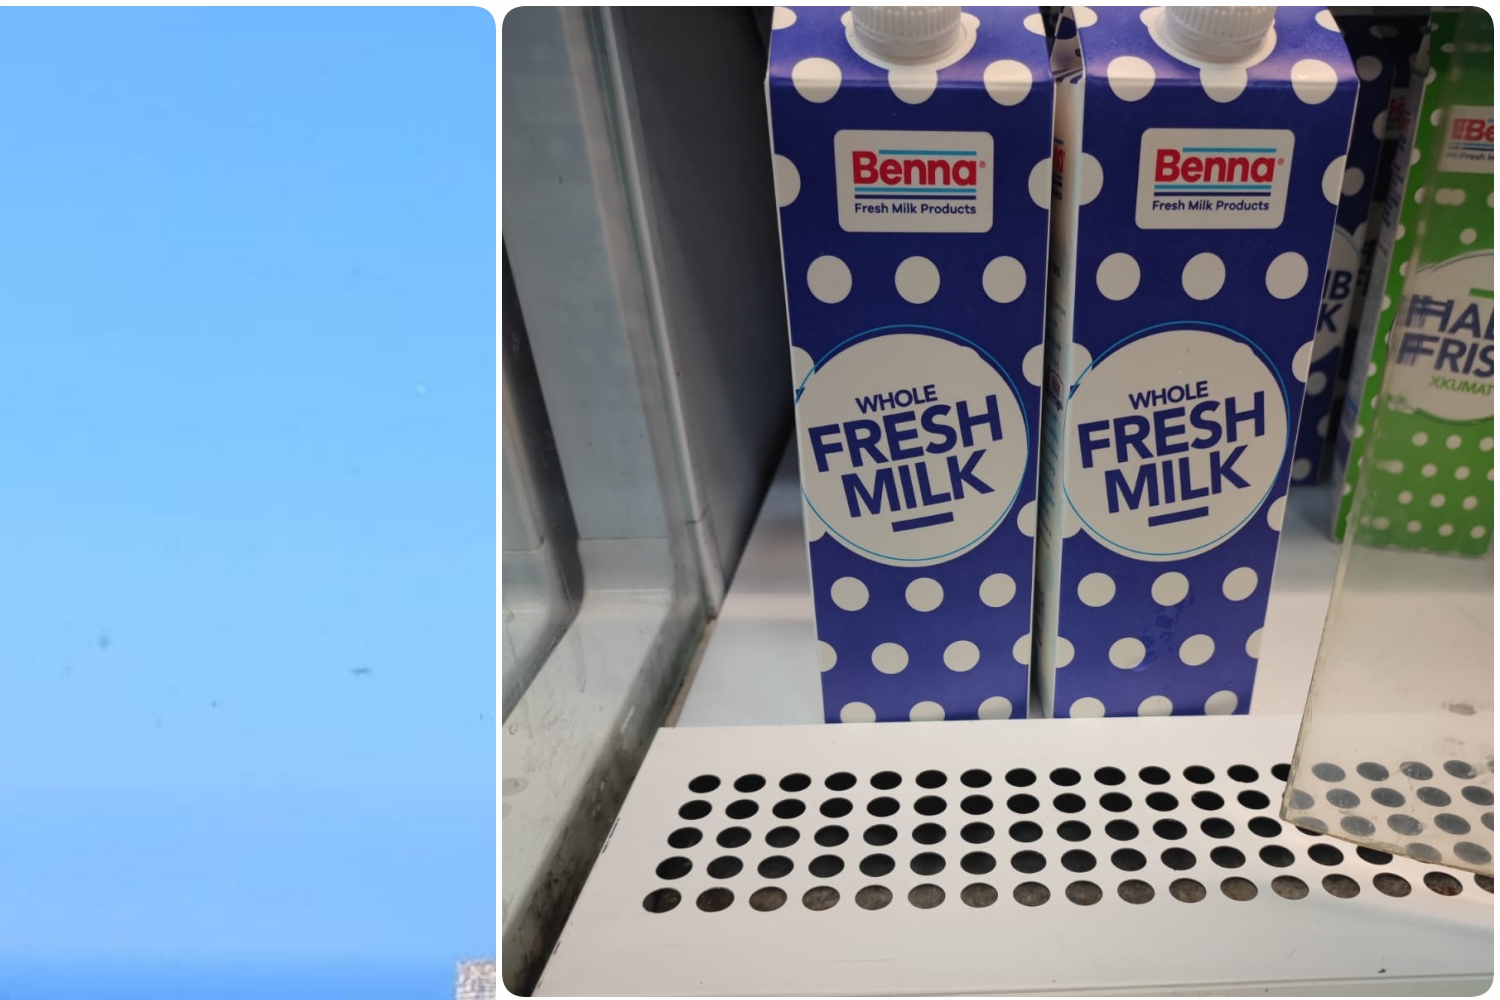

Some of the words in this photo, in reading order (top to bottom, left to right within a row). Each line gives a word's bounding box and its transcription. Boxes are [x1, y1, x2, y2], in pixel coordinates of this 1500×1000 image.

[852, 151, 977, 186] Benna
[1154, 148, 1275, 183] Benna
[854, 203, 889, 214] Fresh
[891, 203, 918, 214] Milk
[921, 203, 977, 216] Products
[1152, 200, 1185, 211] Fresh
[1187, 200, 1212, 211] Milk
[1215, 200, 1270, 213] Products
[855, 384, 938, 414] WHOLE
[1128, 380, 1209, 410] WHOLE
[808, 394, 1003, 473] FRESH
[1077, 390, 1265, 470] FRESH
[841, 449, 995, 518] MILK
[1104, 444, 1251, 515] MILK
